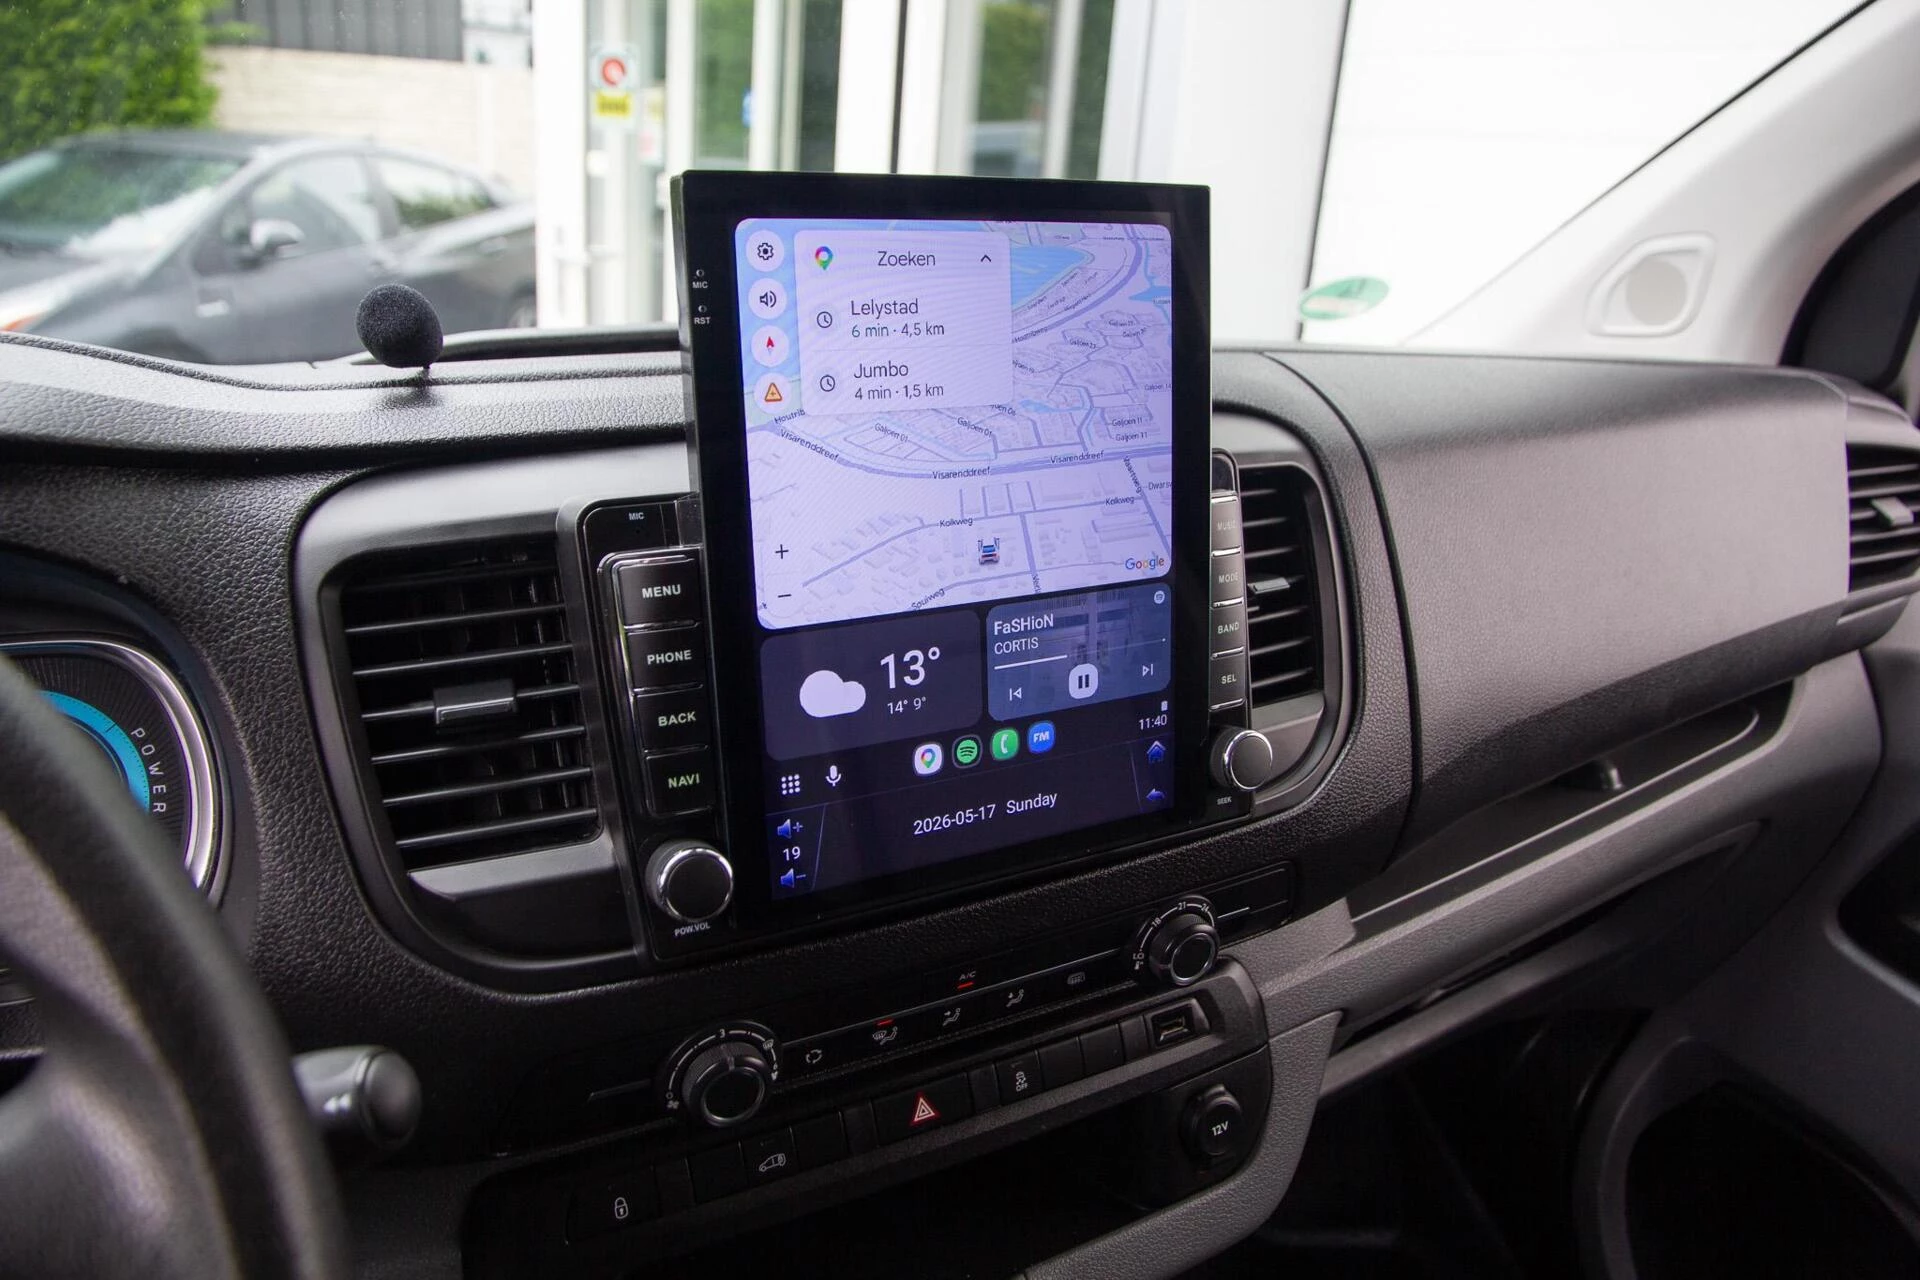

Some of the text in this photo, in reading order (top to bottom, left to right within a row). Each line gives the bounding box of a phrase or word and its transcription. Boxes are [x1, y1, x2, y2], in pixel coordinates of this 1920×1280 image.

[877, 250, 936, 267] Zoeken
[692, 281, 708, 289] MIC
[850, 298, 919, 320] Lelystad
[694, 317, 711, 325] RST
[851, 321, 945, 338] 6 min 4,5 km
[853, 360, 909, 379] Jumbo
[854, 383, 944, 400] 4 min 1,5 km
[779, 429, 840, 463] Visarenddreef
[1050, 450, 1105, 464] Visarenddreef
[932, 466, 991, 481] Visarenddreef
[628, 512, 645, 521] MIC
[939, 516, 974, 529] Kolkweg
[1125, 556, 1165, 571] Google
[1218, 572, 1239, 584] MODE
[641, 583, 682, 600] MENU
[1217, 621, 1240, 634] BAND
[994, 637, 1039, 655] CORTIS
[646, 649, 692, 666] PHONE
[880, 646, 941, 690] 13°
[1221, 674, 1237, 685] SEL
[658, 711, 697, 727] BACK
[1138, 714, 1168, 730] 11:40
[1033, 730, 1051, 745] FM
[130, 727, 166, 813] POWER
[667, 773, 701, 789] NAVI
[913, 792, 1057, 836] 2026-05-17 Sunday
[783, 846, 801, 862] 19
[674, 921, 711, 937] POW.VOL
[1015, 1082, 1029, 1092] OFF
[1211, 1120, 1229, 1137] 12V
